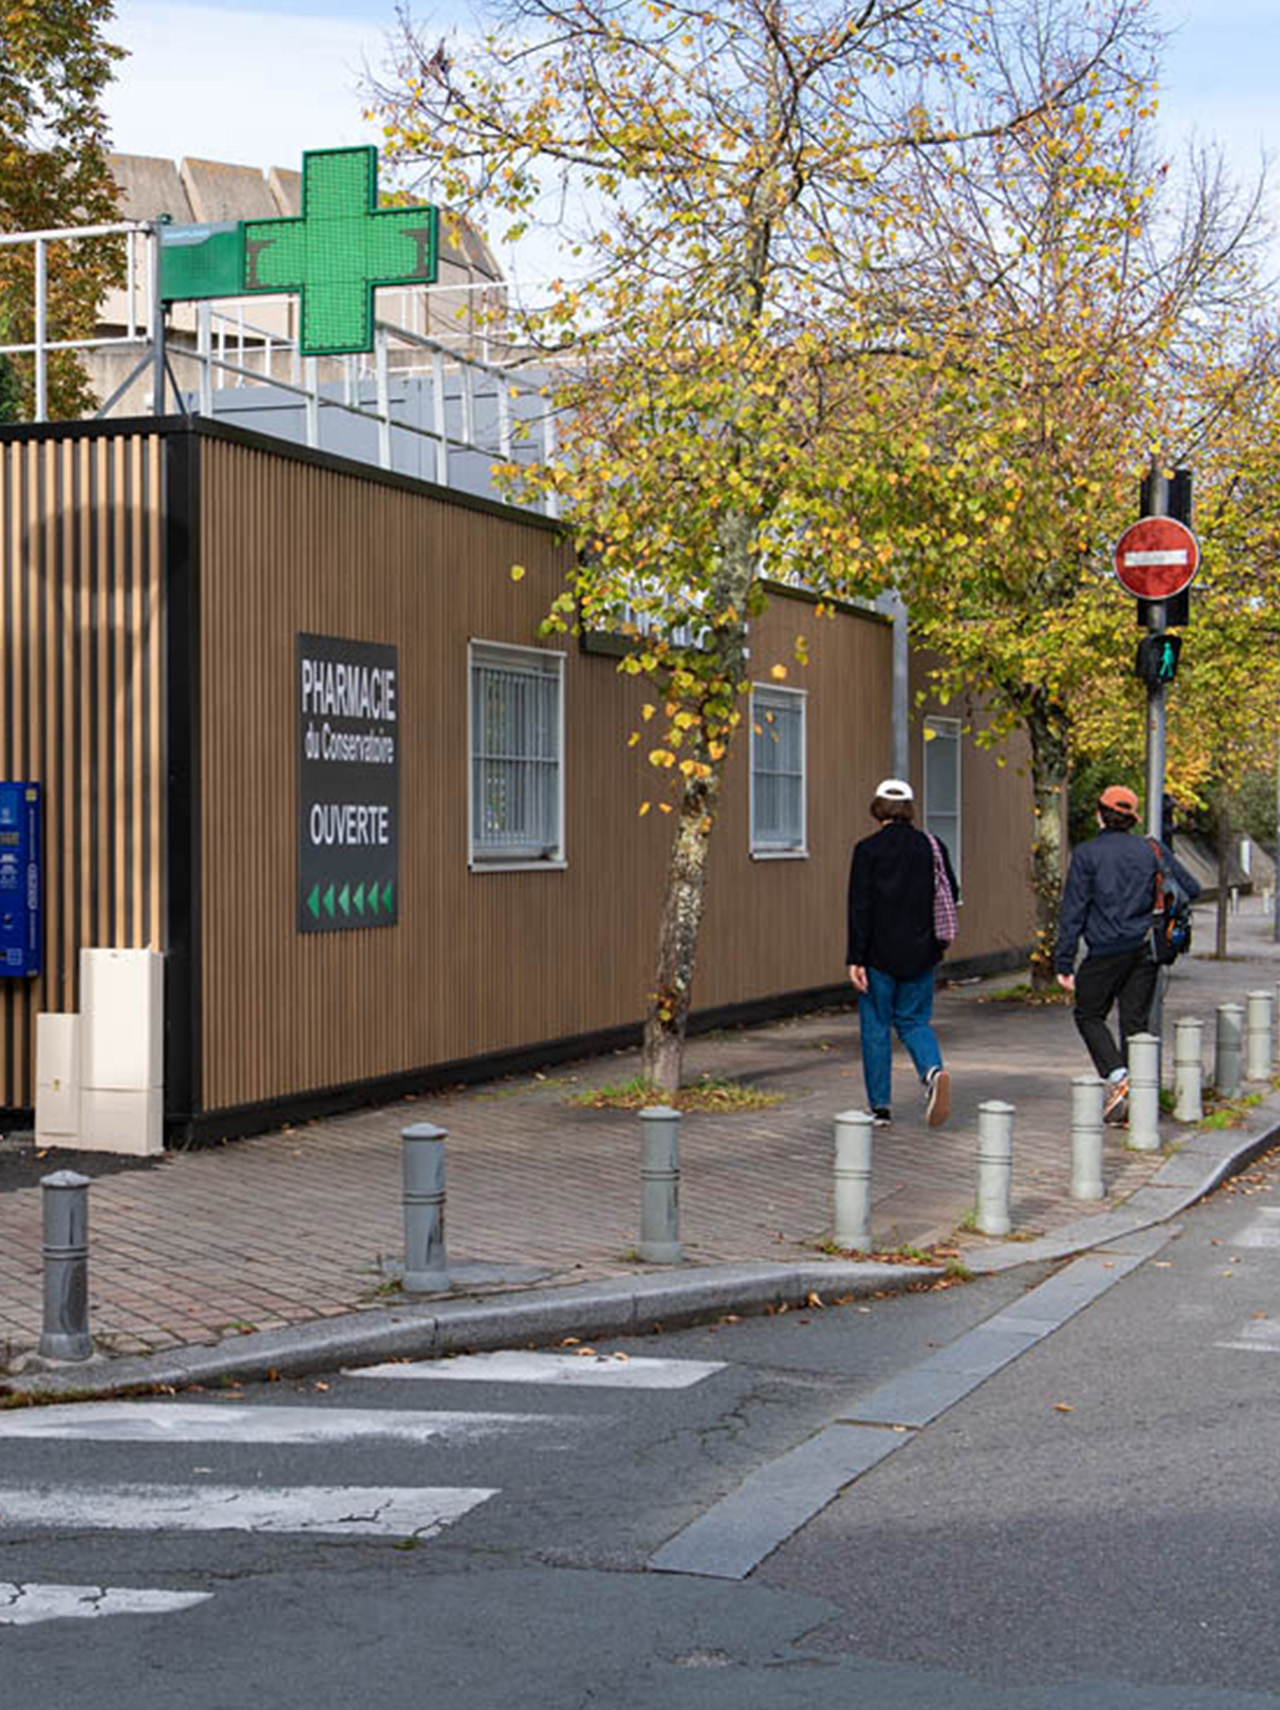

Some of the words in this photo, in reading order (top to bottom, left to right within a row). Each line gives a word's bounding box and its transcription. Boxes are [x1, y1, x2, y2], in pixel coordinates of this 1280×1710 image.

[301, 658, 396, 721] PHARMACIE
[304, 721, 320, 760] du
[321, 722, 394, 764] Conservatoire
[310, 803, 389, 845] OUVERTE
